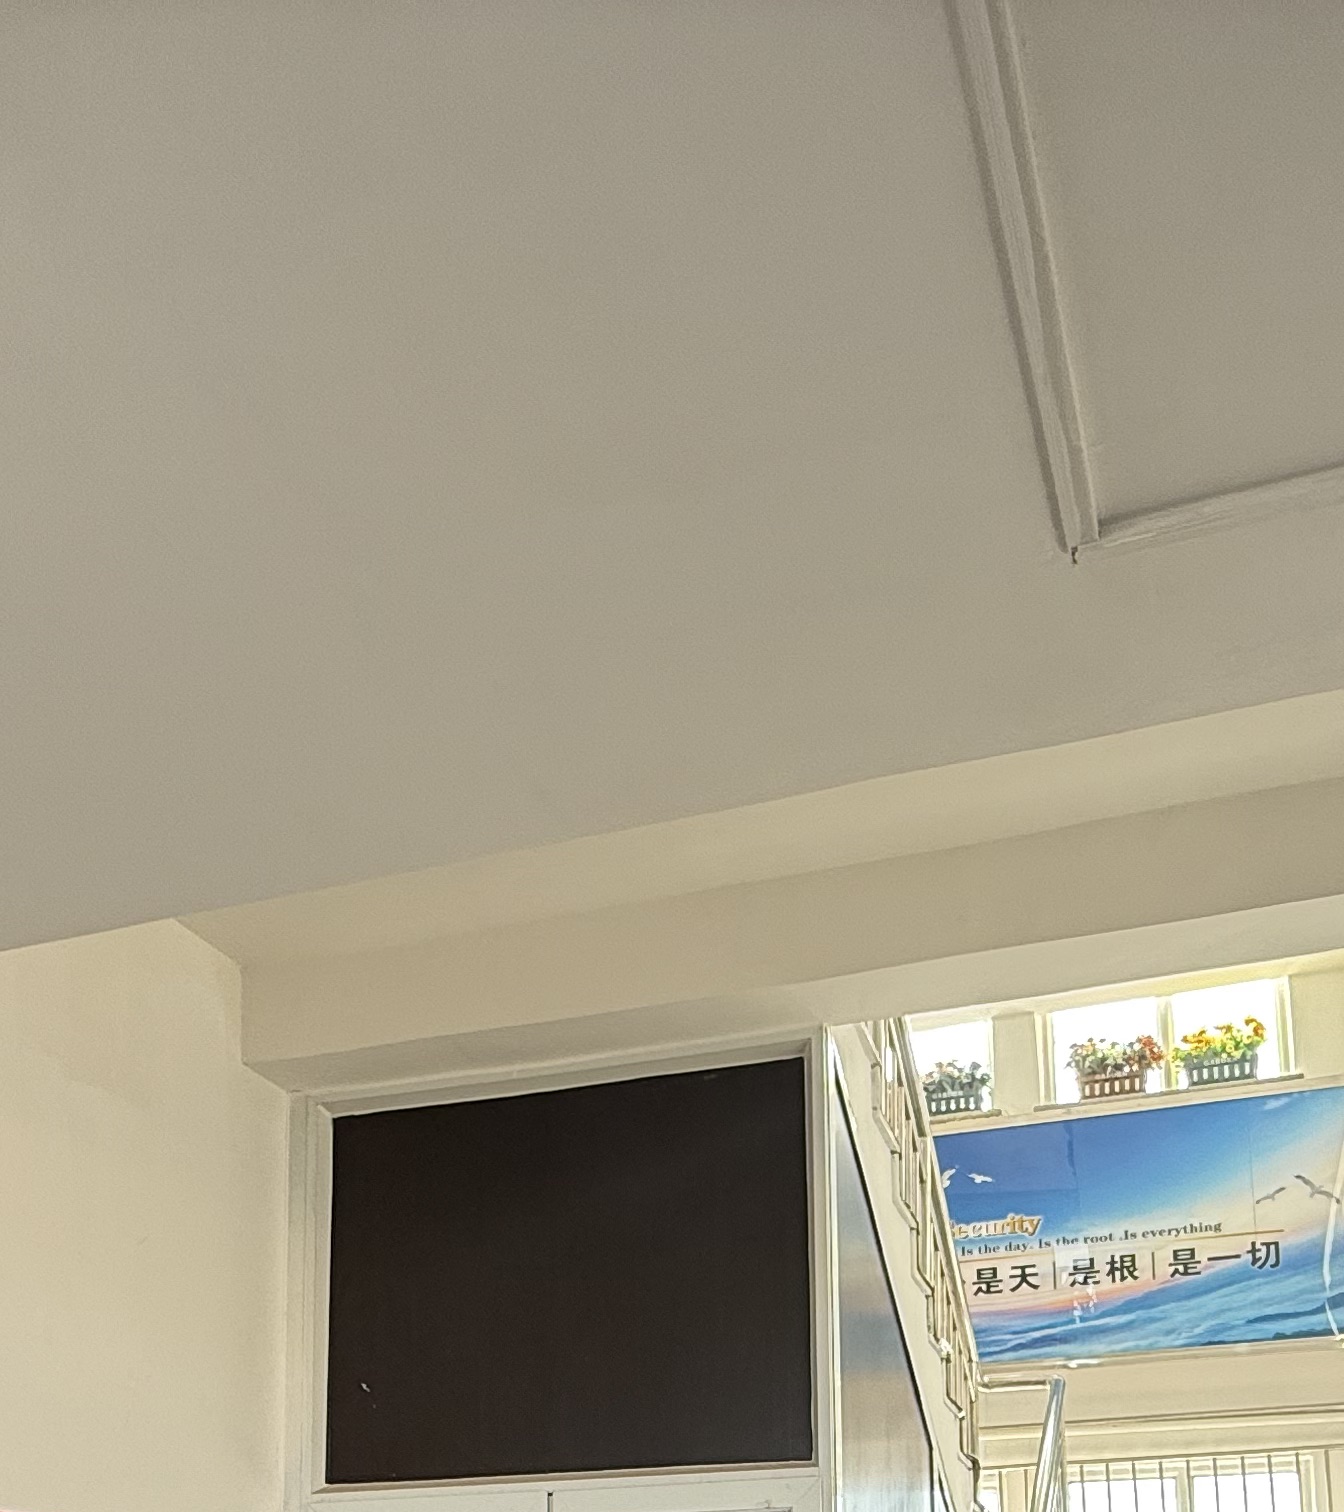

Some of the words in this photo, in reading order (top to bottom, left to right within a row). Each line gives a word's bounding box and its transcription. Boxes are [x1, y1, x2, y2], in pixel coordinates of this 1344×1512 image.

[978, 1243, 1001, 1255] the
[1038, 1237, 1051, 1249] Is
[1056, 1234, 1080, 1246] the
[1083, 1231, 1115, 1245] root
[1142, 1221, 1223, 1239] everything
[962, 1263, 1041, 1297] 是天
[1068, 1253, 1140, 1288] 是根
[1168, 1240, 1281, 1279] 是一切
